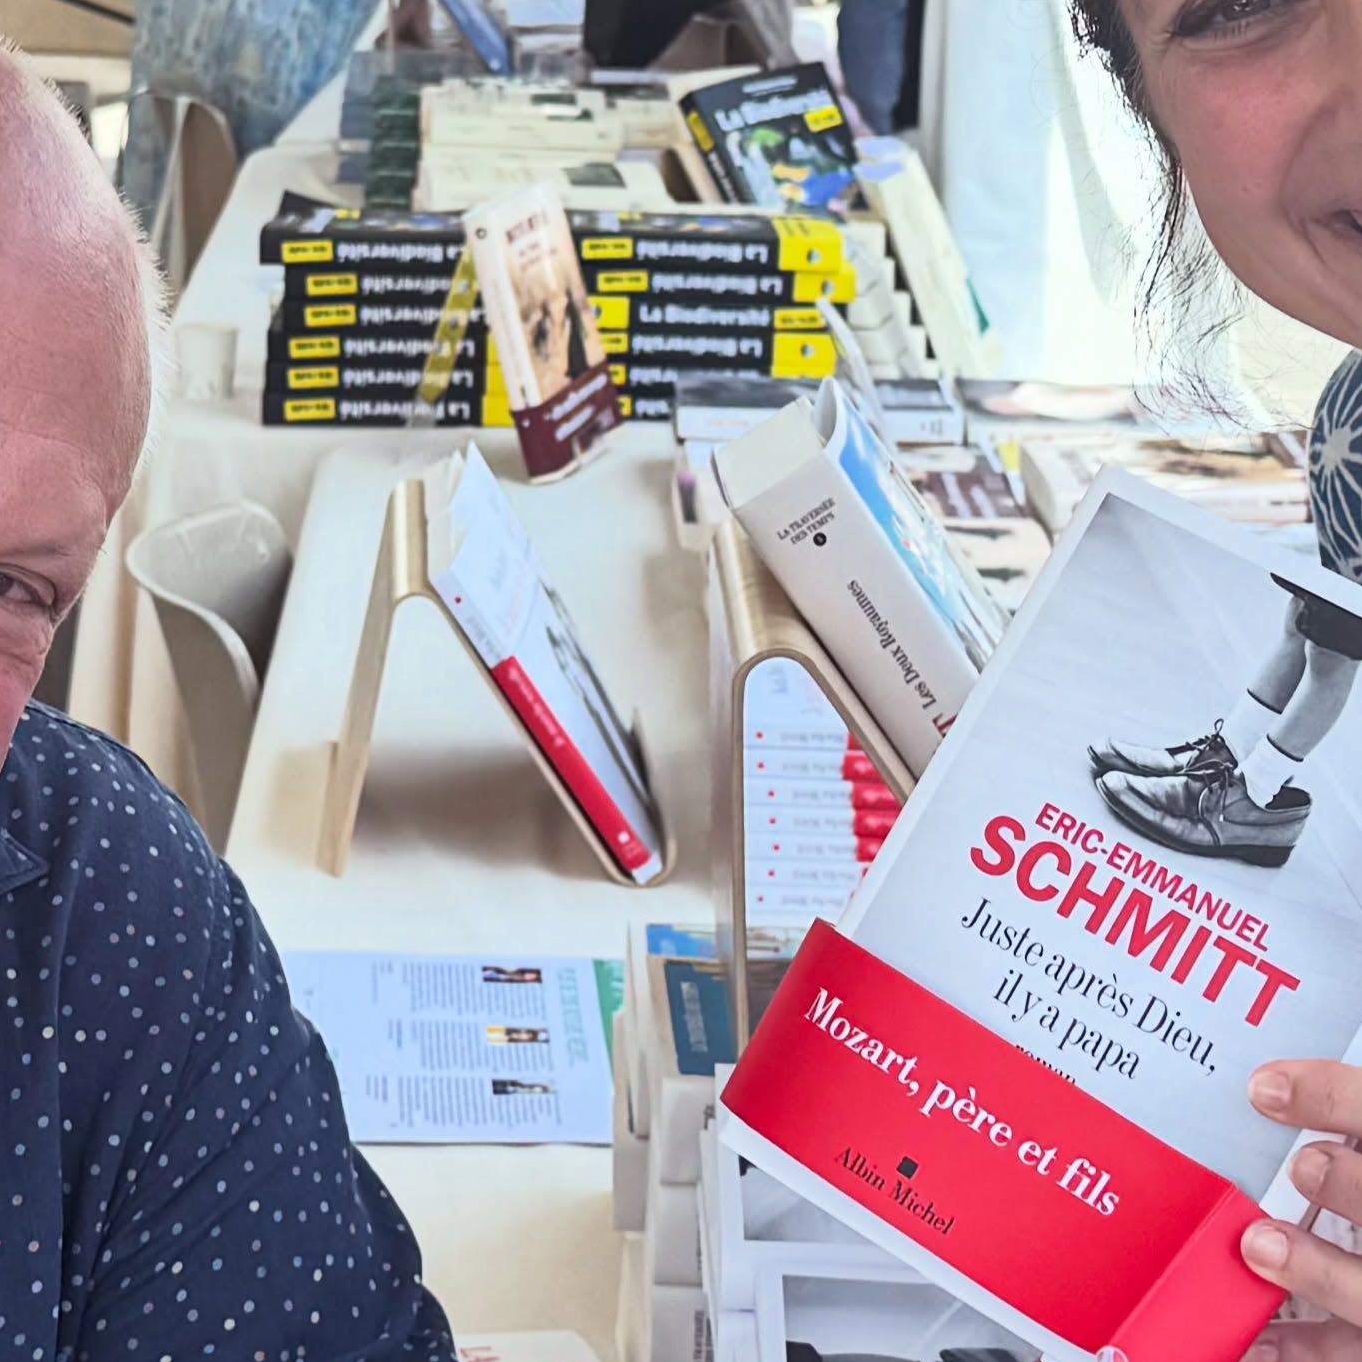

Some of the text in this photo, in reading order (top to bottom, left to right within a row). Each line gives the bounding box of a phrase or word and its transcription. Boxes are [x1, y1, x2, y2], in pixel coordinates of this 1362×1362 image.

[777, 526, 793, 541] LA
[802, 512, 835, 538] TEMPS
[847, 579, 937, 709] Les Deux Royaumes
[970, 815, 1301, 1028] SCHMITT
[1035, 802, 1269, 952] ERIC-EMMANUEL
[961, 897, 1217, 1077] Juste après Dieu,
[993, 969, 1141, 1079] il y a papa
[804, 987, 1120, 1216] Mozart, père et fils
[834, 1147, 955, 1236] Albin Michel
